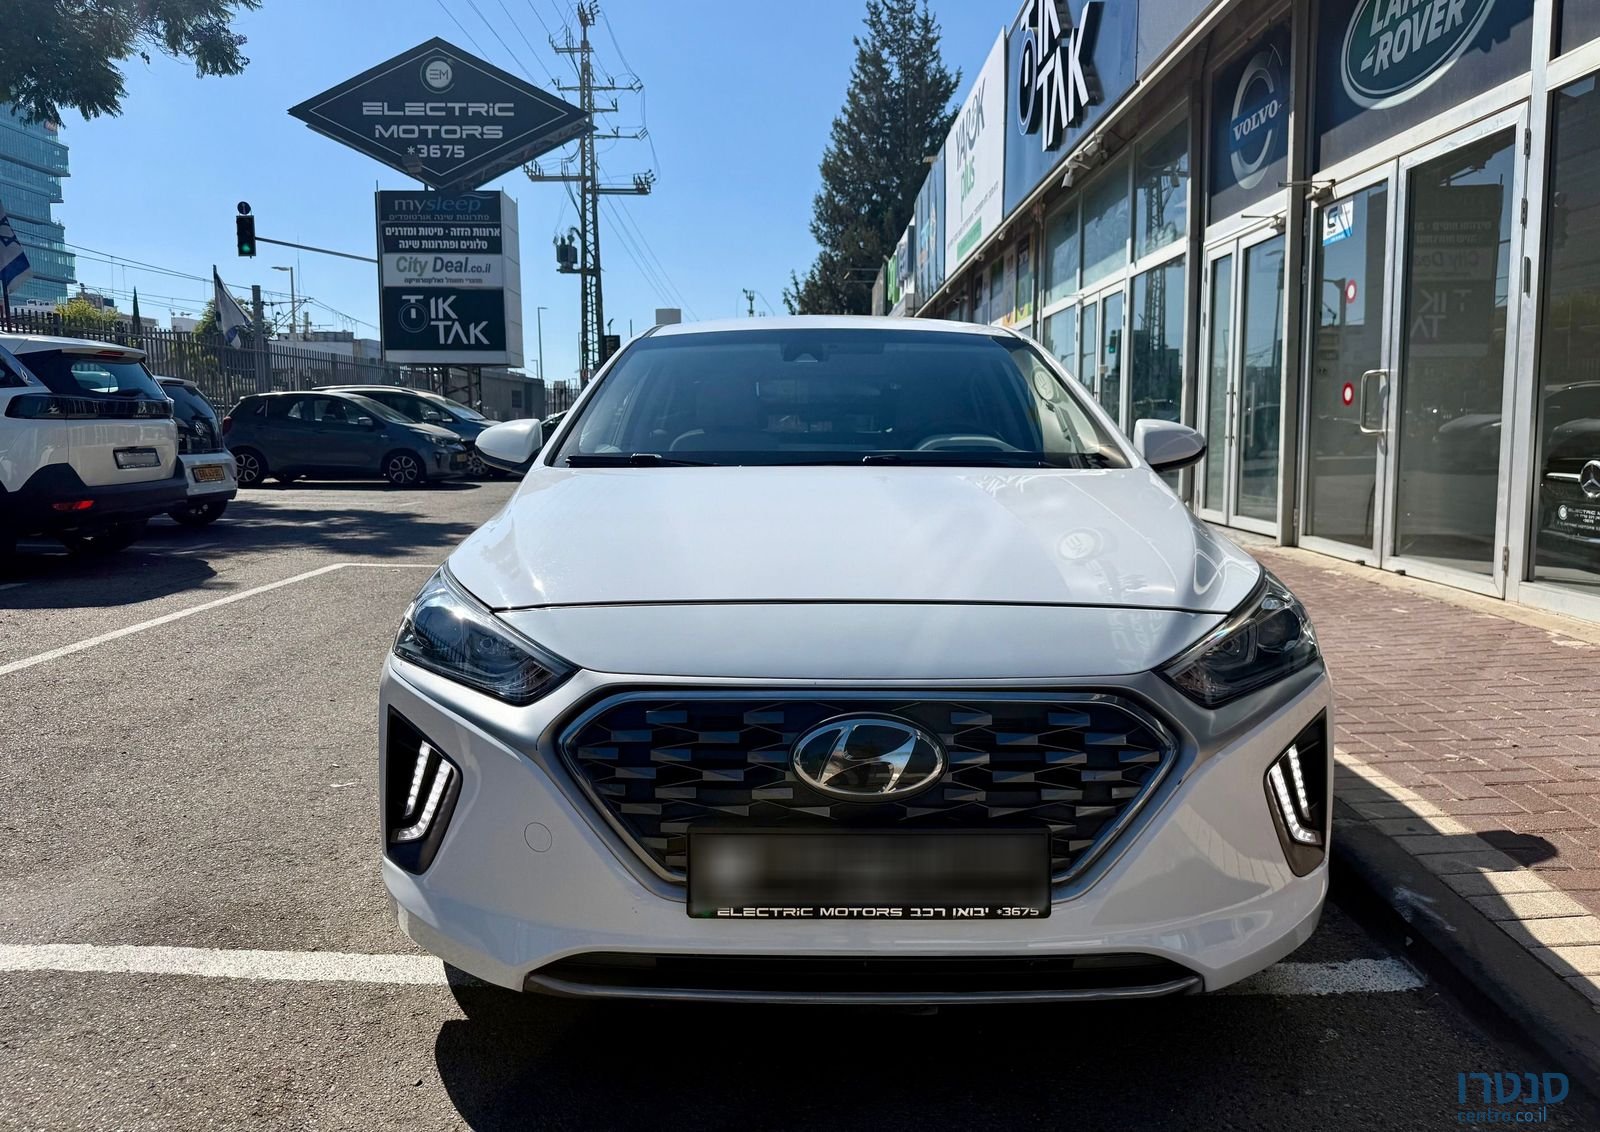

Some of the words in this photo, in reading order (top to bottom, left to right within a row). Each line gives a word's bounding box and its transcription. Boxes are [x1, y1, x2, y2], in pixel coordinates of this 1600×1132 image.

[1373, 0, 1466, 77] ROVER
[1036, 1, 1090, 152] TAK
[955, 78, 986, 172] YAROK
[1233, 99, 1278, 141] VOLVO
[375, 124, 503, 139] MOTORS
[394, 195, 481, 213] mysleep
[385, 227, 417, 236] ומזרנים
[418, 227, 444, 236] מיטות
[450, 227, 471, 237] הזזה
[472, 228, 501, 237] ארונות
[398, 240, 420, 249] שינה
[421, 240, 459, 249] ופתרונות
[460, 238, 488, 249] סלונים
[396, 256, 428, 277] City
[432, 256, 491, 273] Deal.co.il
[401, 295, 458, 326] TIK
[430, 321, 490, 344] TAK
[819, 908, 903, 917] MOTORS
[910, 908, 946, 917] רכב
